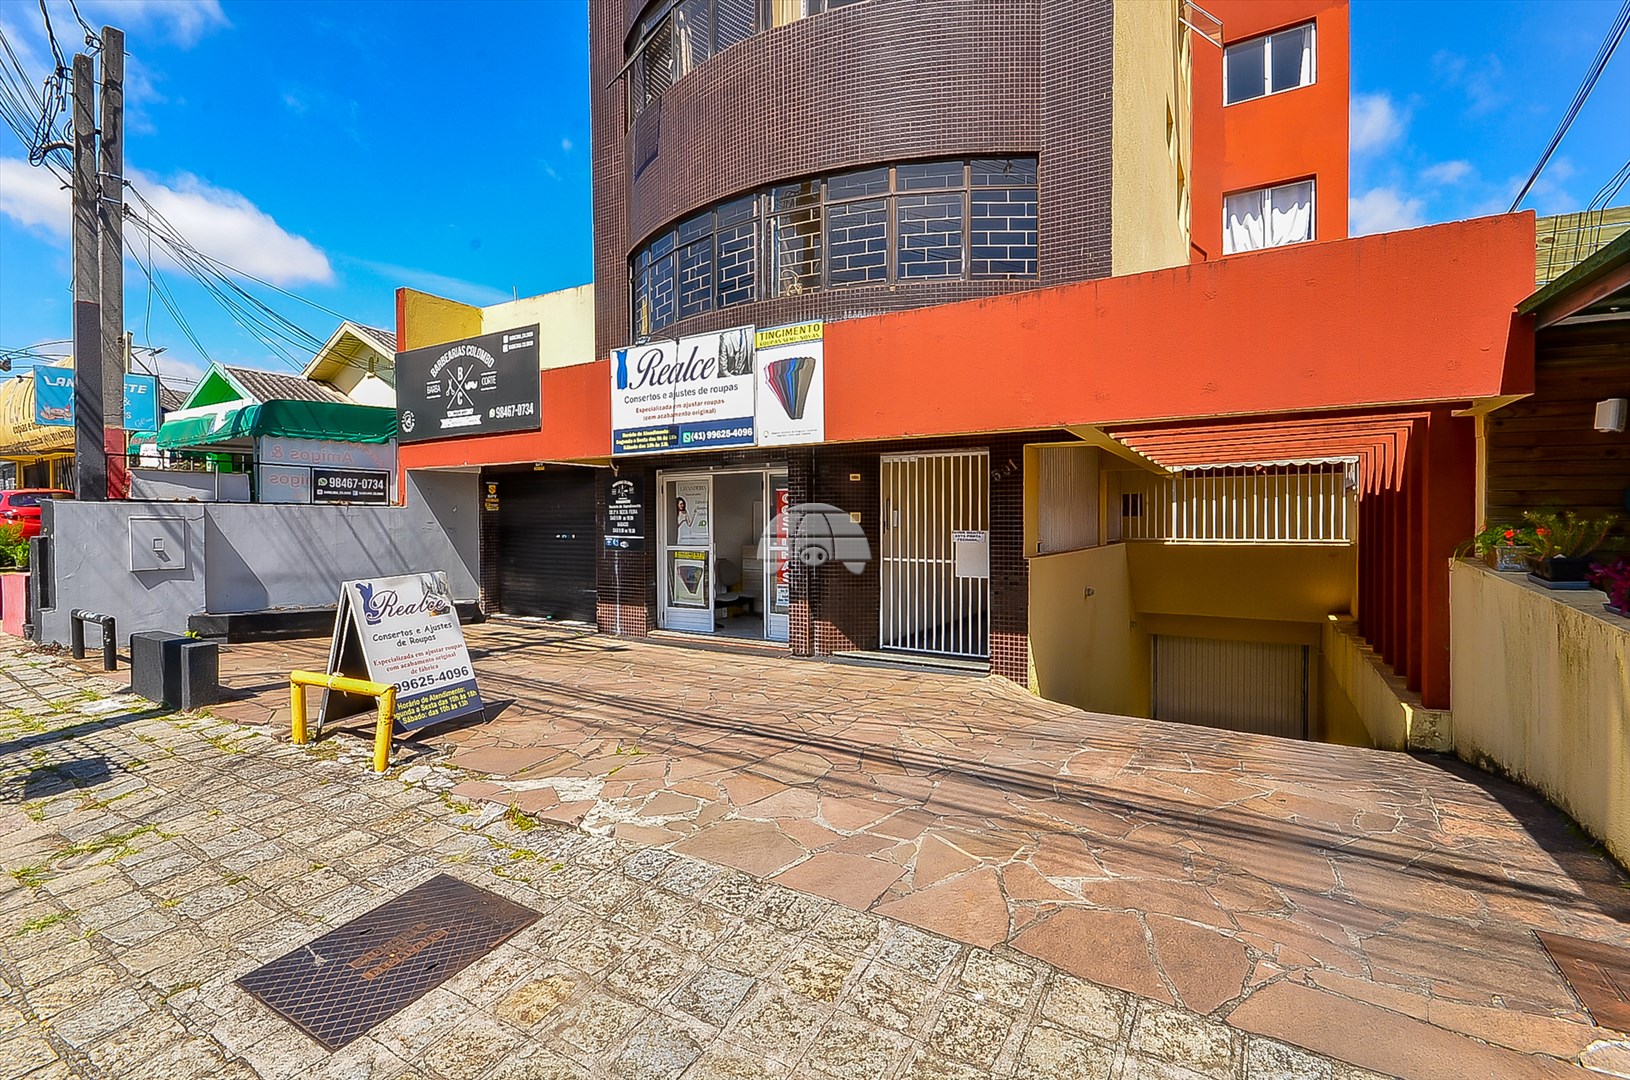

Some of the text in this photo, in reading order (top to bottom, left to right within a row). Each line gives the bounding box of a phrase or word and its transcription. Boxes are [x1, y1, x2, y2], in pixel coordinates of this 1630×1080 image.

[760, 324, 820, 341] TINGIMENTO
[430, 345, 495, 378] BARBEARIAS COLOMBO
[629, 346, 716, 390] Realce
[624, 393, 661, 404] Consertos
[698, 386, 708, 396] de
[710, 383, 740, 394] roupas
[496, 402, 534, 418] 98467-0734
[691, 427, 753, 442] (41) 99625-4096
[329, 476, 384, 491] 98467-0734
[366, 590, 447, 620] Realce
[372, 629, 414, 642] Consertos
[424, 622, 453, 634] Ajustes
[396, 634, 437, 648] de Roupas
[373, 652, 414, 667] Especializada
[415, 651, 425, 659] em
[425, 647, 444, 658] ajustar
[386, 652, 456, 673] com acabamento original
[410, 663, 439, 675] de fábrica
